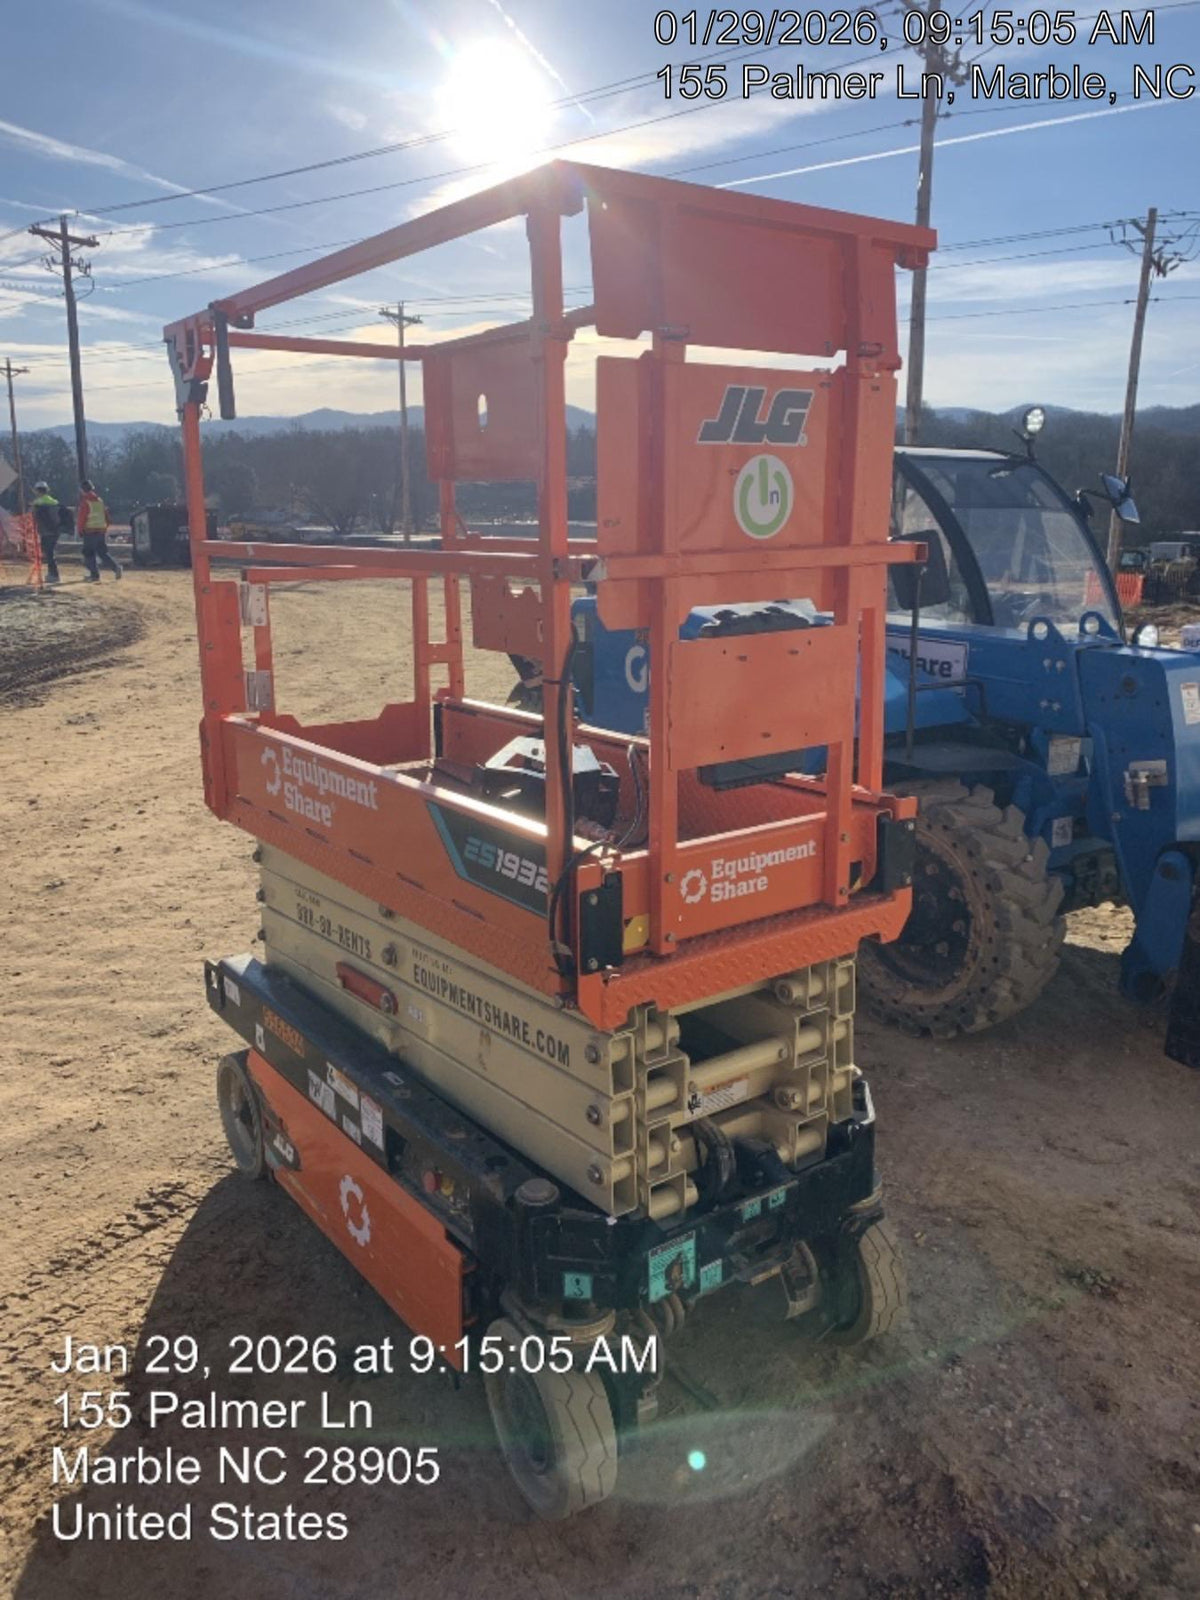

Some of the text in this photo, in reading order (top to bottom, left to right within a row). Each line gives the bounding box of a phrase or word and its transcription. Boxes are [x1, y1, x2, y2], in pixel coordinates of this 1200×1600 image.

[697, 384, 814, 446] JLG
[281, 745, 379, 812] Equipment
[283, 781, 332, 828] Share
[711, 839, 817, 880] Equipment
[710, 875, 769, 903] Share
[413, 963, 571, 1068] EQUIPMENTSHARE.COM
